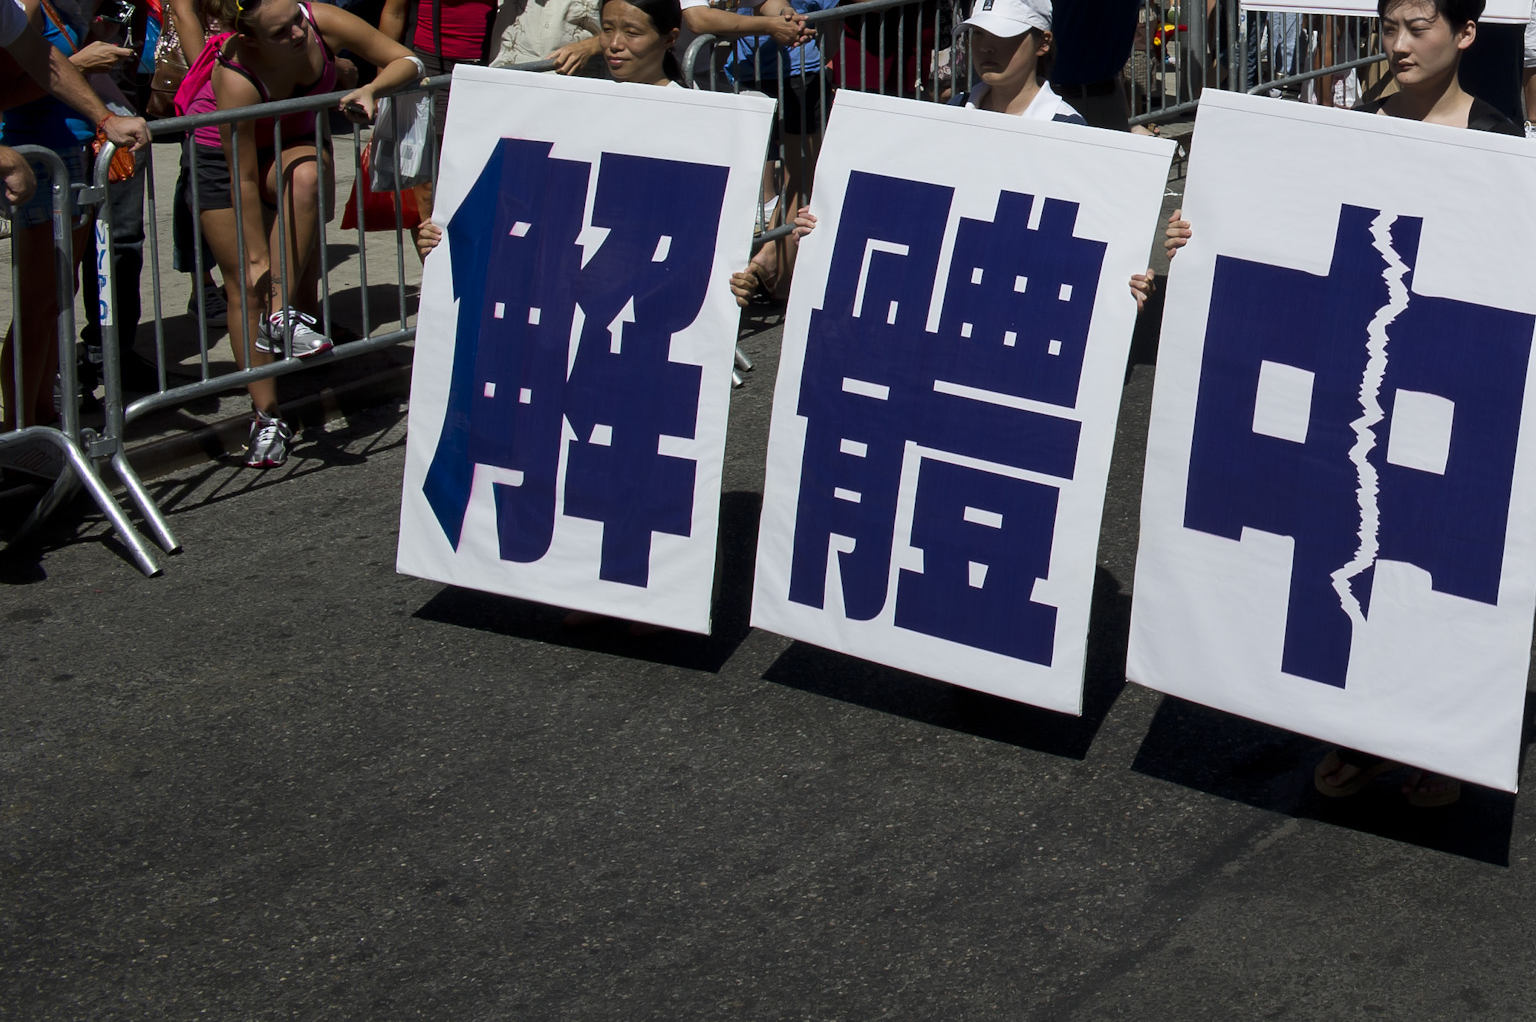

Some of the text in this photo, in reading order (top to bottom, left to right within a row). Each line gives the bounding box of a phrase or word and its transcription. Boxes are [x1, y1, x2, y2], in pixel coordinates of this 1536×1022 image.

[426, 138, 727, 586] 解
[789, 171, 1106, 665] 體
[1184, 204, 1535, 687] 中
